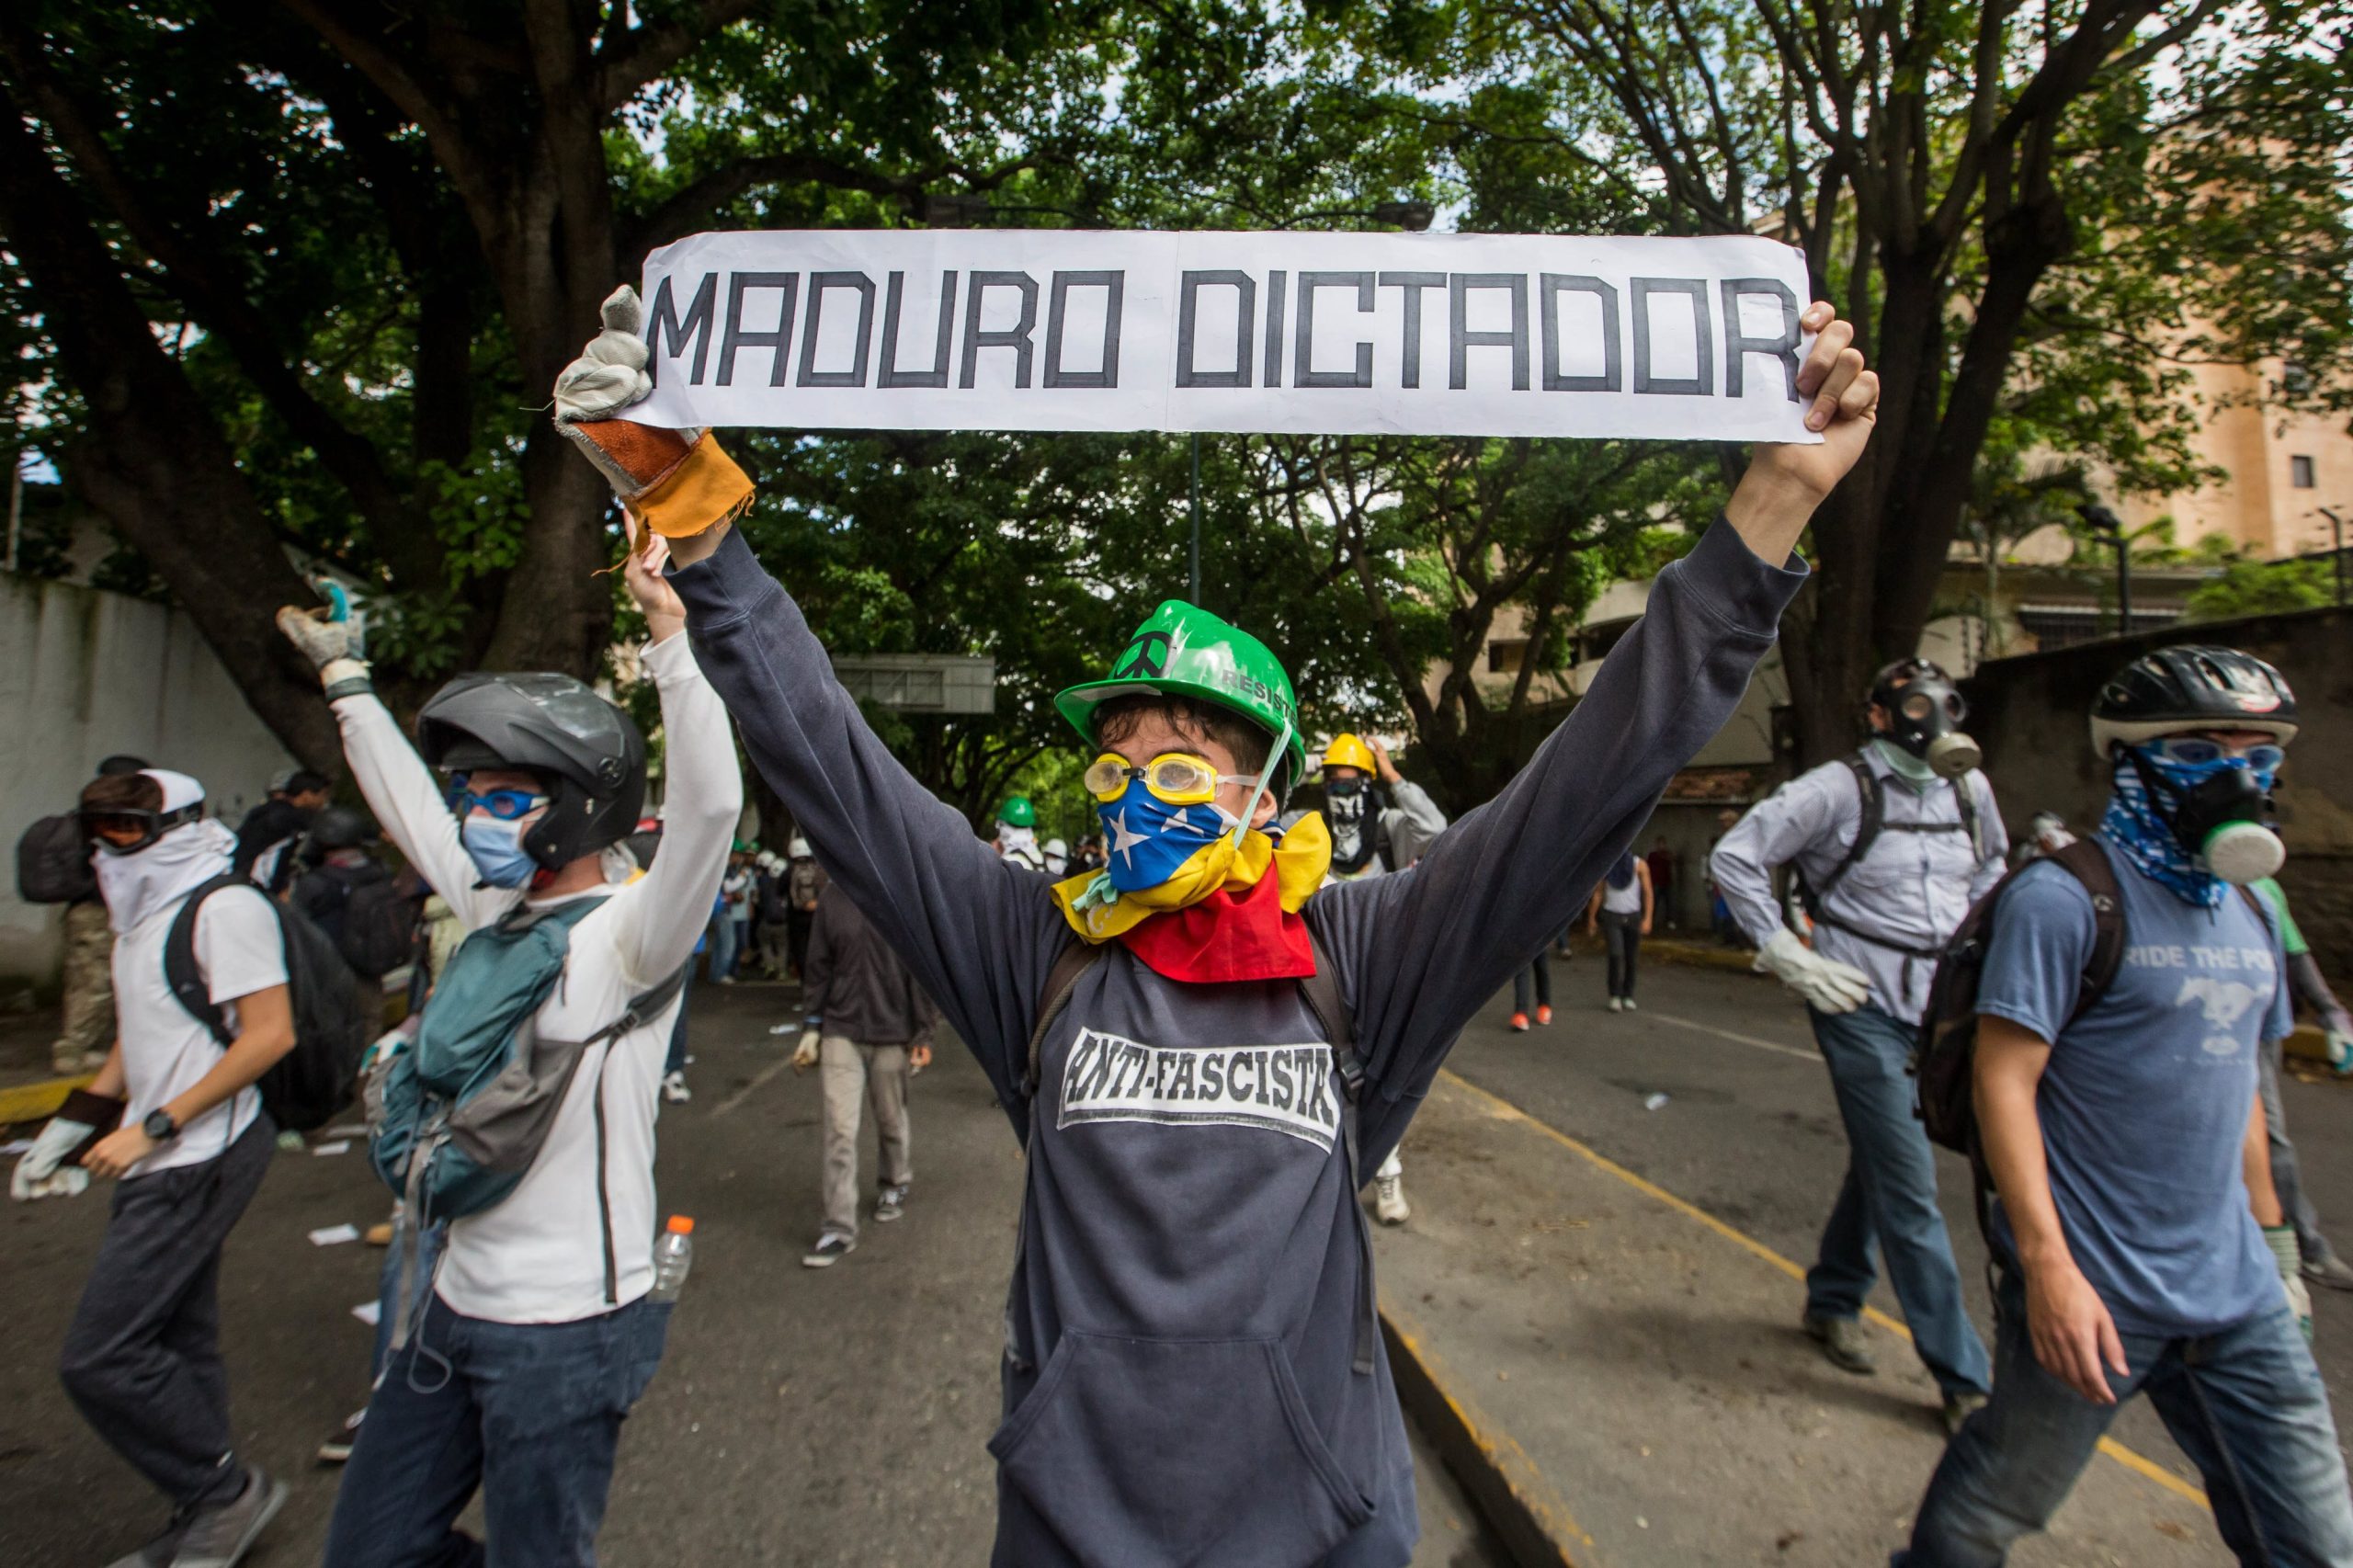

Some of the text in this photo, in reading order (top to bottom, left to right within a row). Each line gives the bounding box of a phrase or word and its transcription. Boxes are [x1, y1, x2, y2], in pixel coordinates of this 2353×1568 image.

[646, 270, 1802, 402] MADURO DICTADOR
[2190, 947, 2239, 970] THE
[1063, 1032, 1335, 1129] ANTI-FASCISTA
